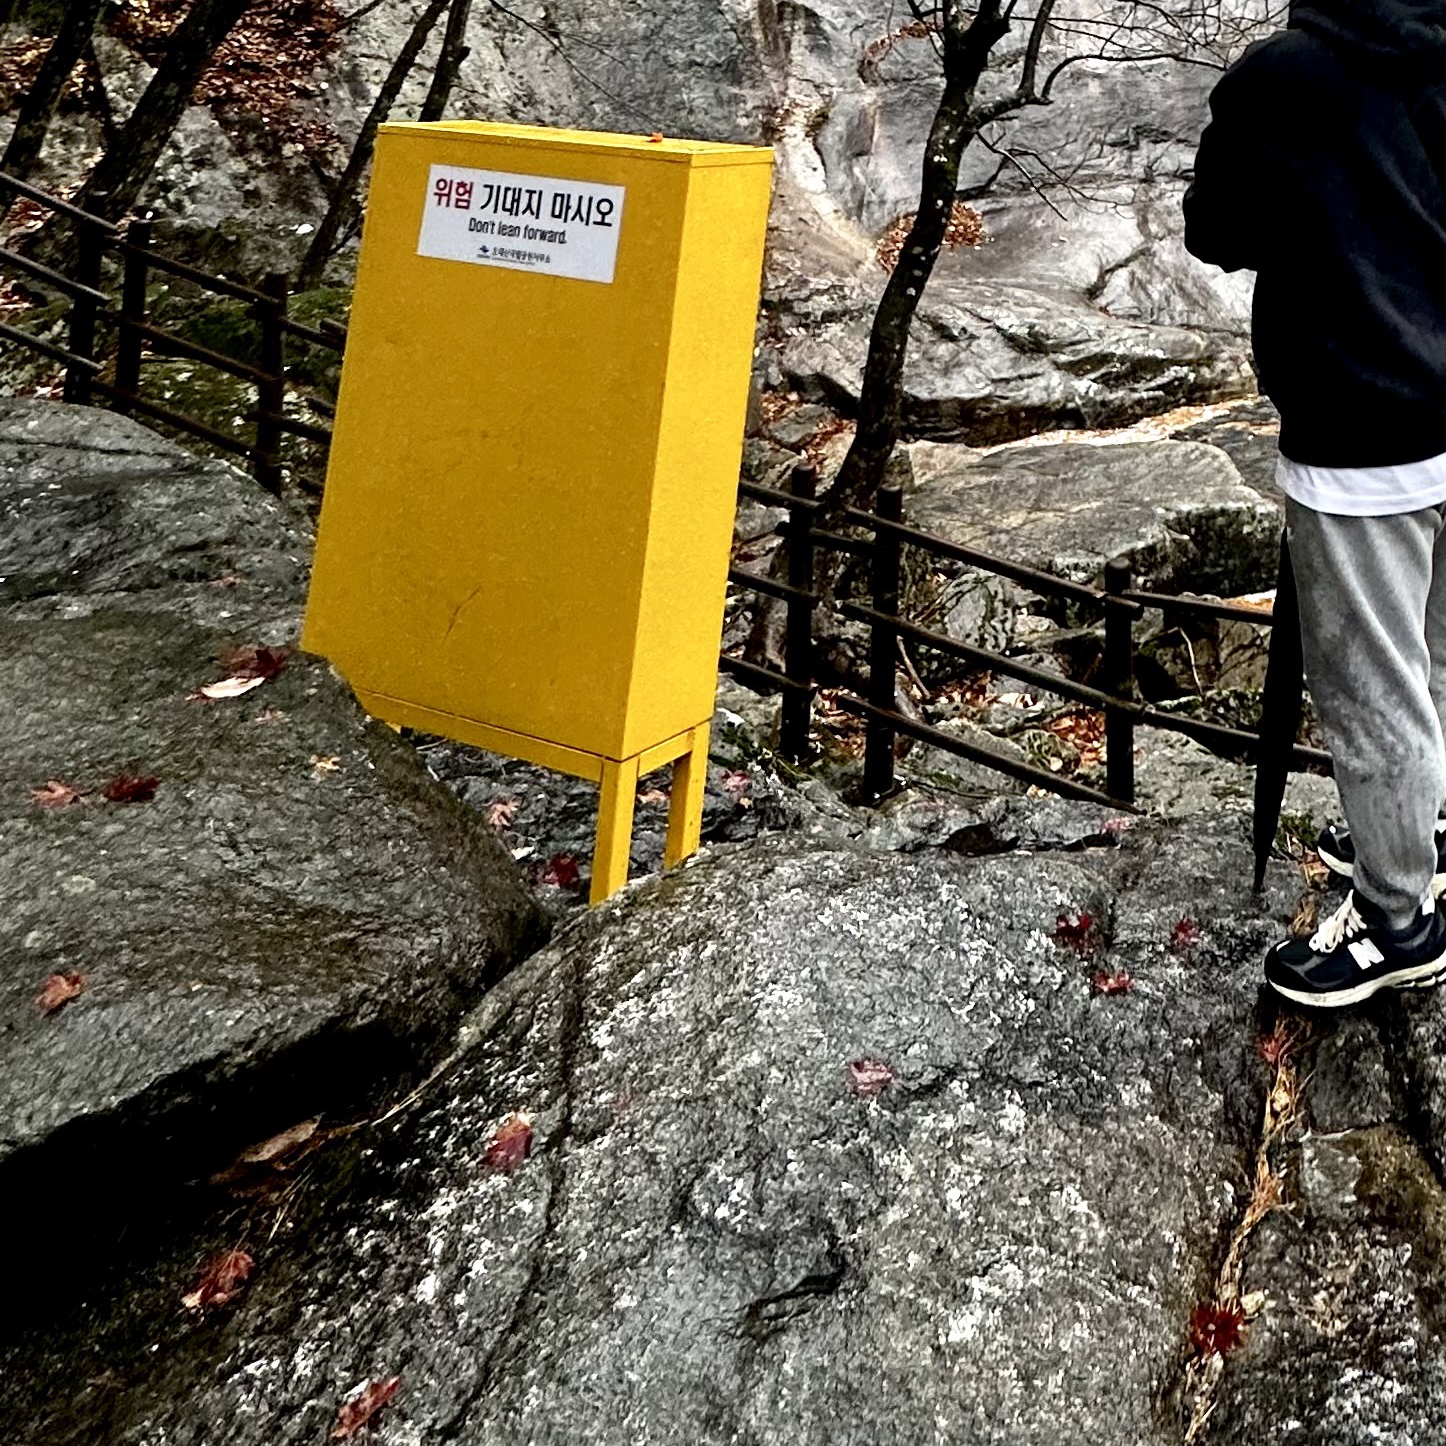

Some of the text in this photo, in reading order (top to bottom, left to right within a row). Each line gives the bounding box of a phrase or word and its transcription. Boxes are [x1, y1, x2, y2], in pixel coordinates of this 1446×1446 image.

[434, 178, 614, 227] 위험 기대지 마시오
[468, 217, 495, 235] Don't
[498, 221, 521, 238] lean
[1347, 937, 1385, 970] N
